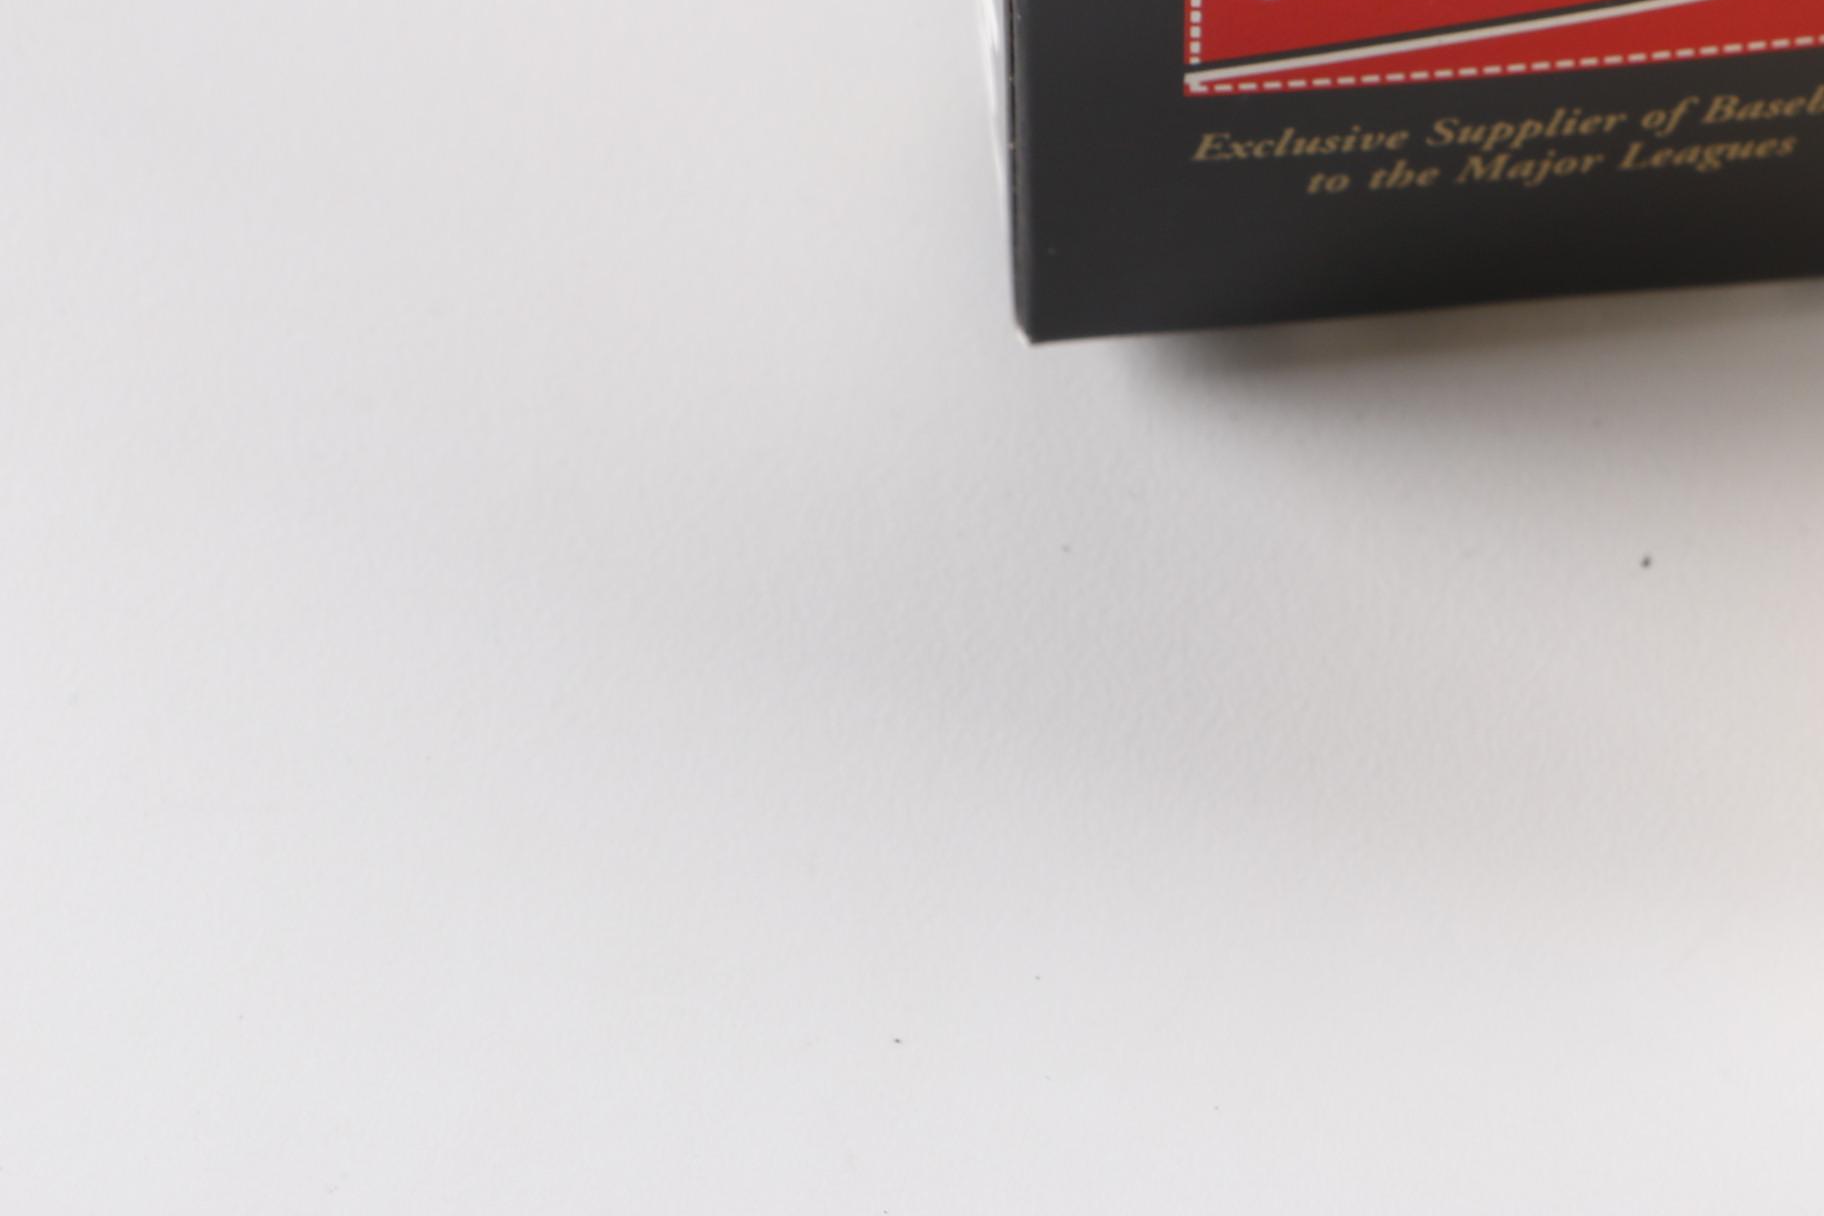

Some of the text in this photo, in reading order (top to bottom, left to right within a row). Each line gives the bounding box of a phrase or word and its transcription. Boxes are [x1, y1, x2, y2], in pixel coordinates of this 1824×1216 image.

[1193, 127, 1410, 161] Exclusive
[1425, 106, 1626, 152] Supplier
[1641, 96, 1699, 137] of
[1306, 136, 1797, 194] to the Major Leagues
